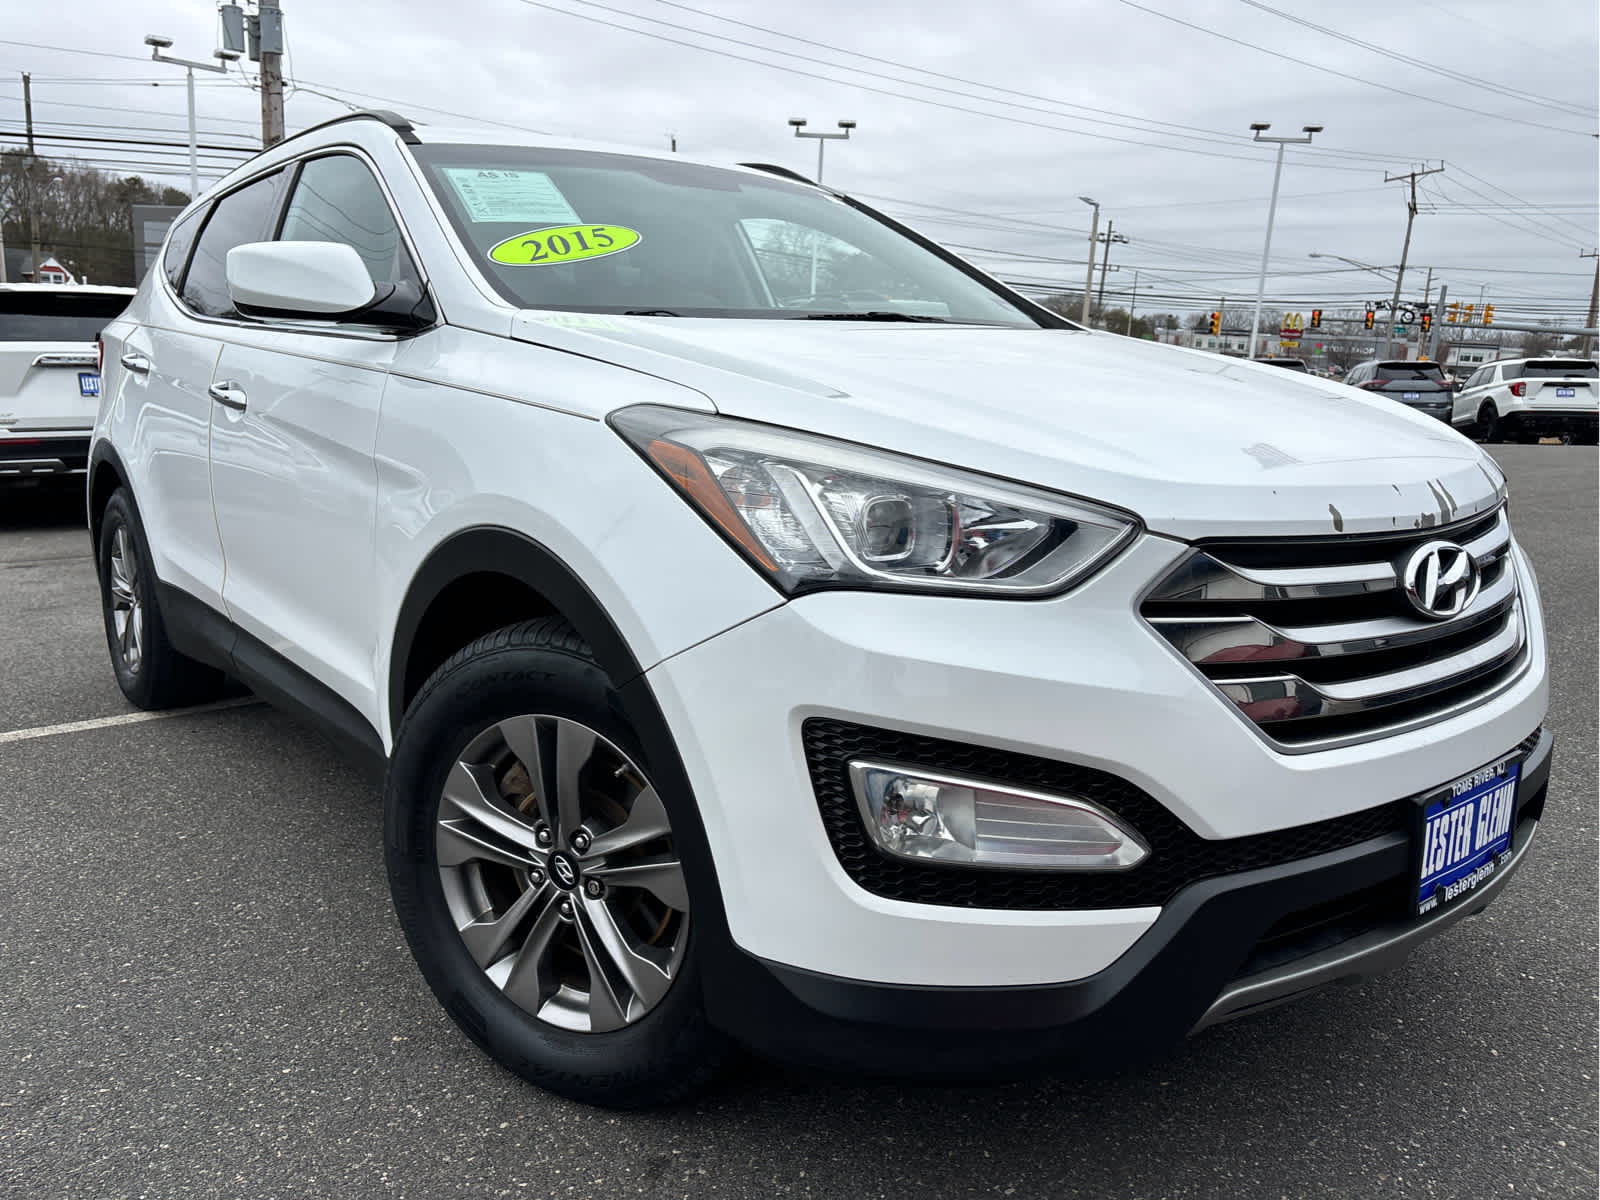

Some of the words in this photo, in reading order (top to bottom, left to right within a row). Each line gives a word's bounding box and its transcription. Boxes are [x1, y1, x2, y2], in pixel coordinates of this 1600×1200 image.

[521, 227, 614, 262] 2015
[81, 376, 100, 391] LEST
[1451, 779, 1473, 797] TOMS
[1496, 761, 1506, 776] NJ
[1420, 802, 1475, 880] LESTER
[1475, 780, 1516, 851] GLENN
[1444, 861, 1495, 902] lesterglenn
